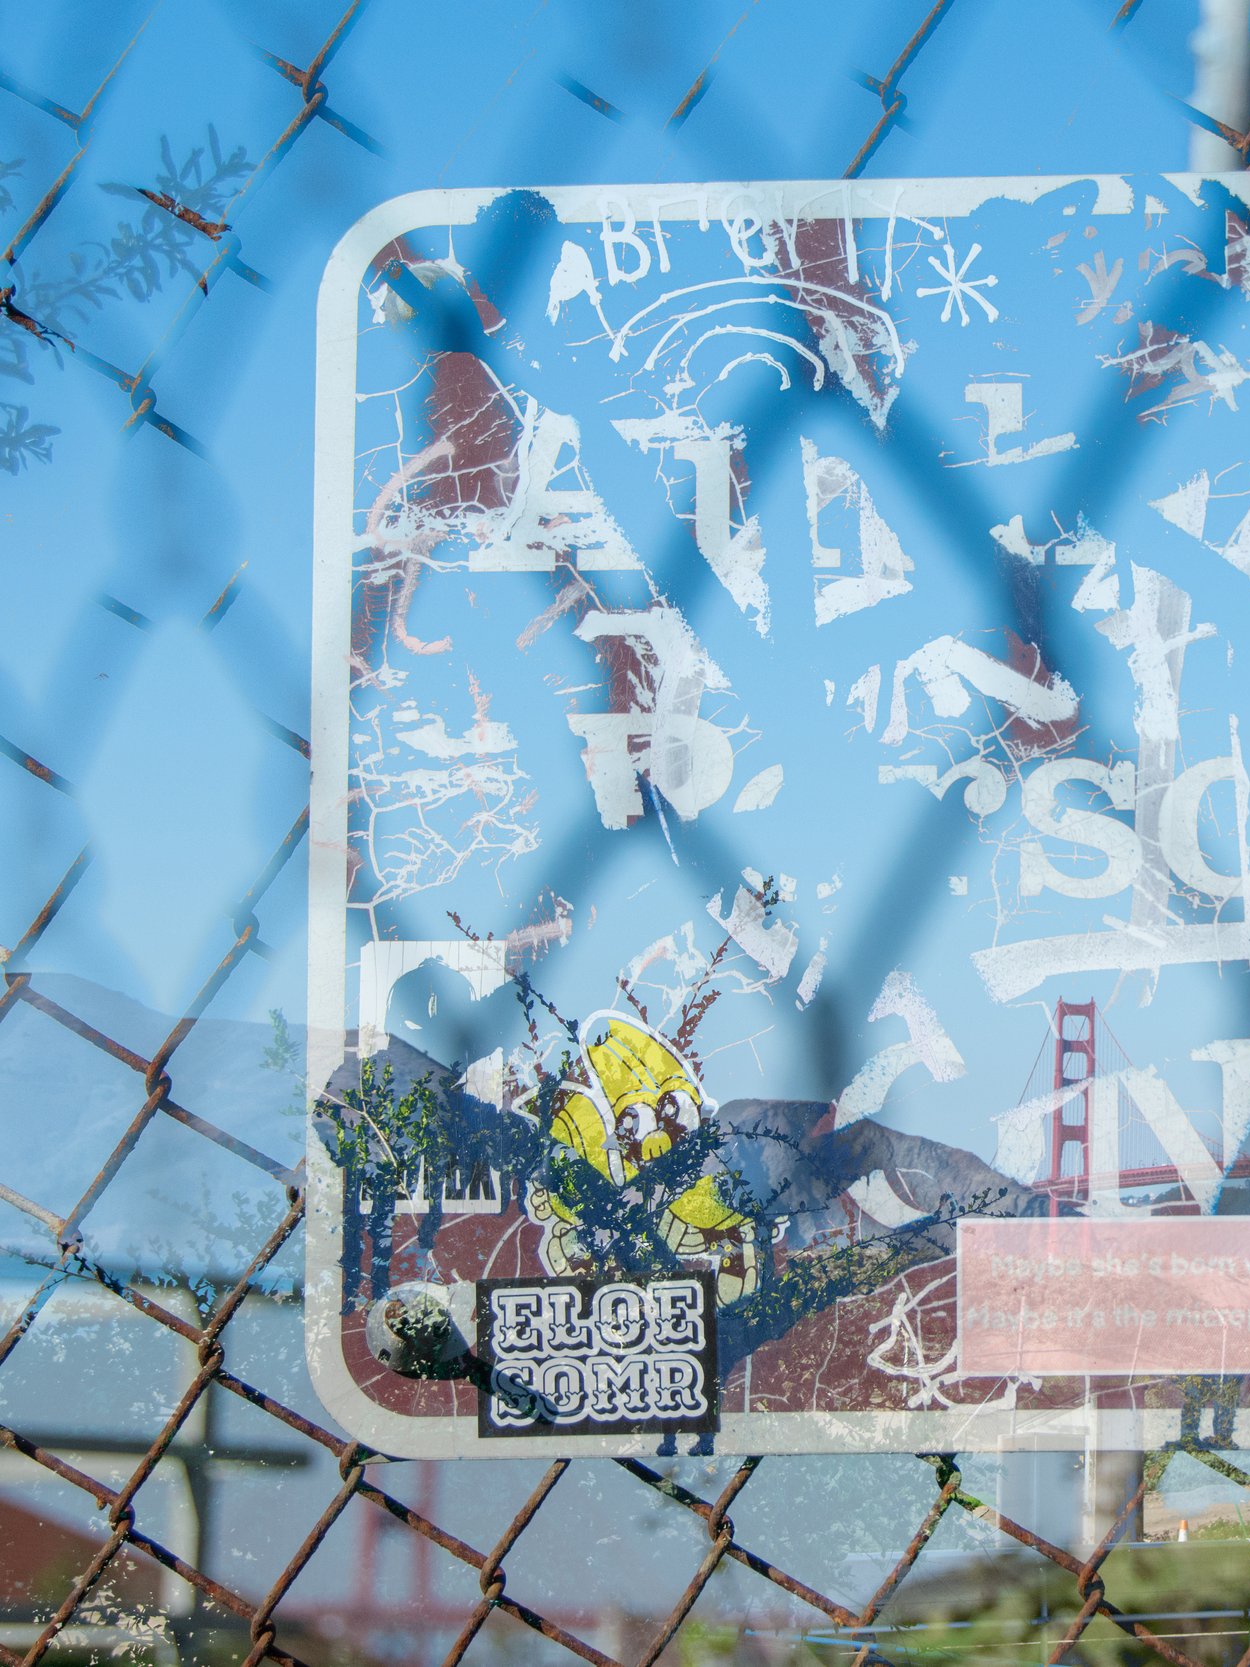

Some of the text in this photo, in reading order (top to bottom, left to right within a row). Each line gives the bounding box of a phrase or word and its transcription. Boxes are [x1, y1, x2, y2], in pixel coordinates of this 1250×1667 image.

[991, 1254, 1083, 1284] Maybe
[1092, 1251, 1162, 1277] she's
[1171, 1251, 1237, 1275] born
[491, 1279, 706, 1359] ELOE
[967, 1303, 1058, 1333] Maybe
[1067, 1303, 1106, 1329] it's
[1114, 1303, 1158, 1328] the
[491, 1353, 707, 1427] SOMR
